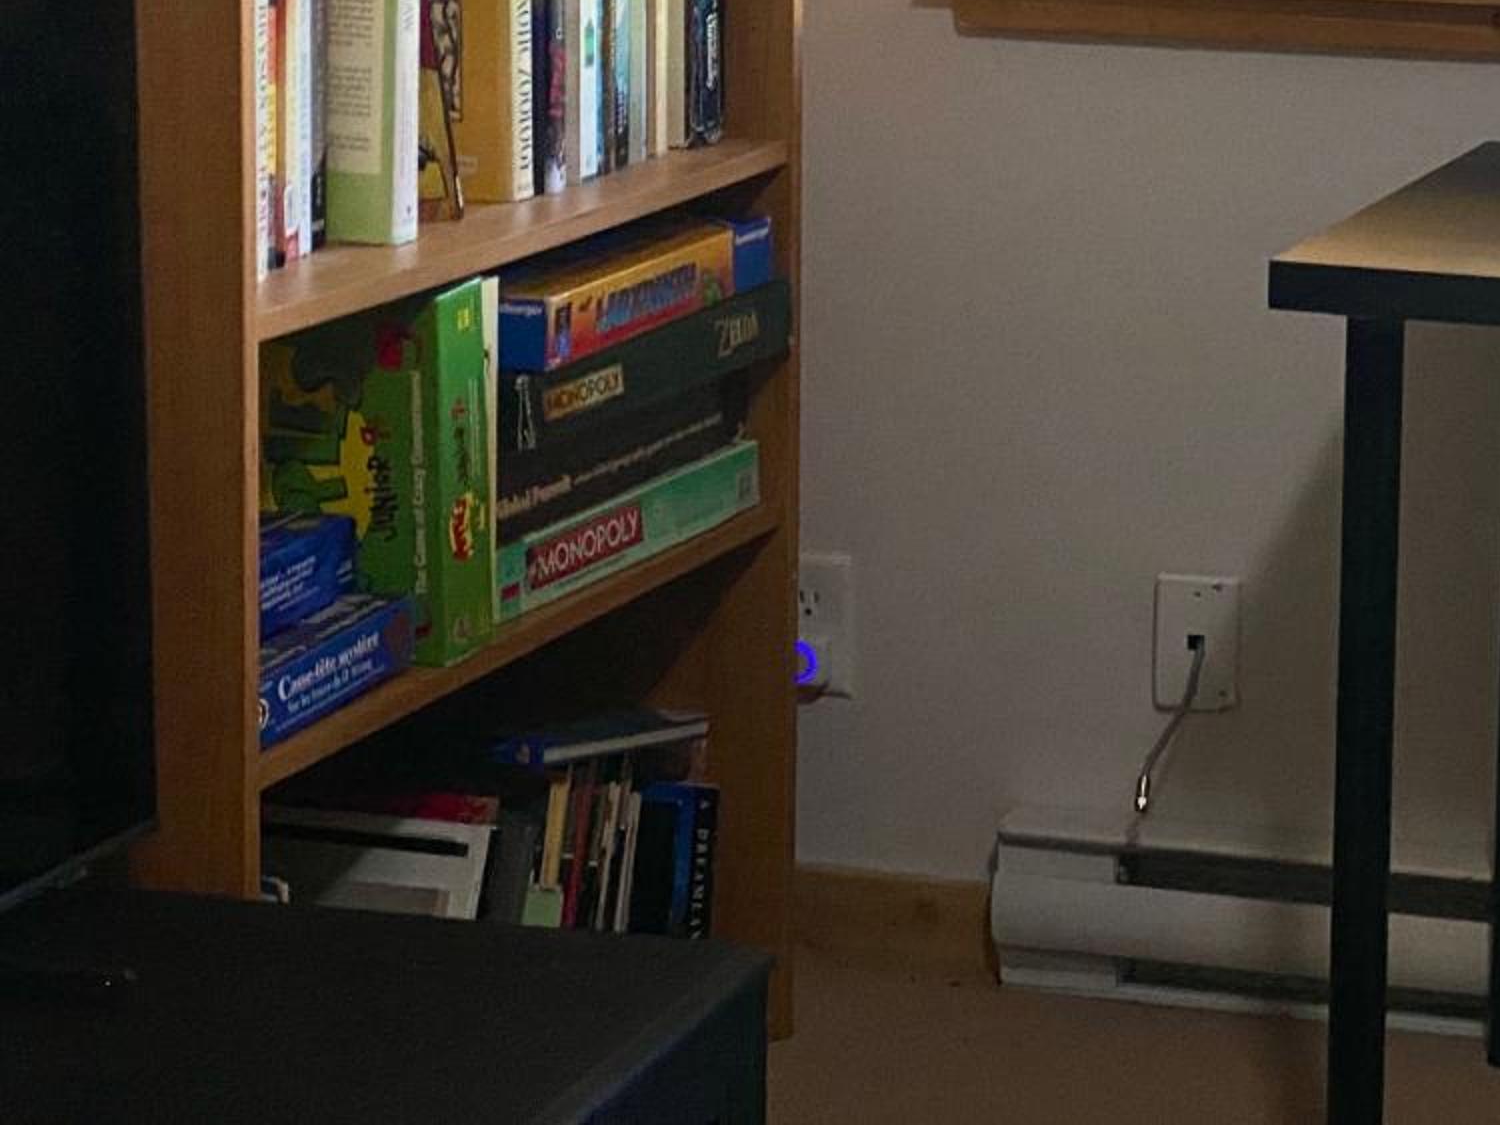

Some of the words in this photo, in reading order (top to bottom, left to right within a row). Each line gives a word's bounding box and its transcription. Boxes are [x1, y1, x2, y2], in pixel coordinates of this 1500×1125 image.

[517, 66, 531, 172] ZOOLOGY
[547, 371, 620, 415] MONOPOLY
[536, 509, 639, 579] MONOPOLY
